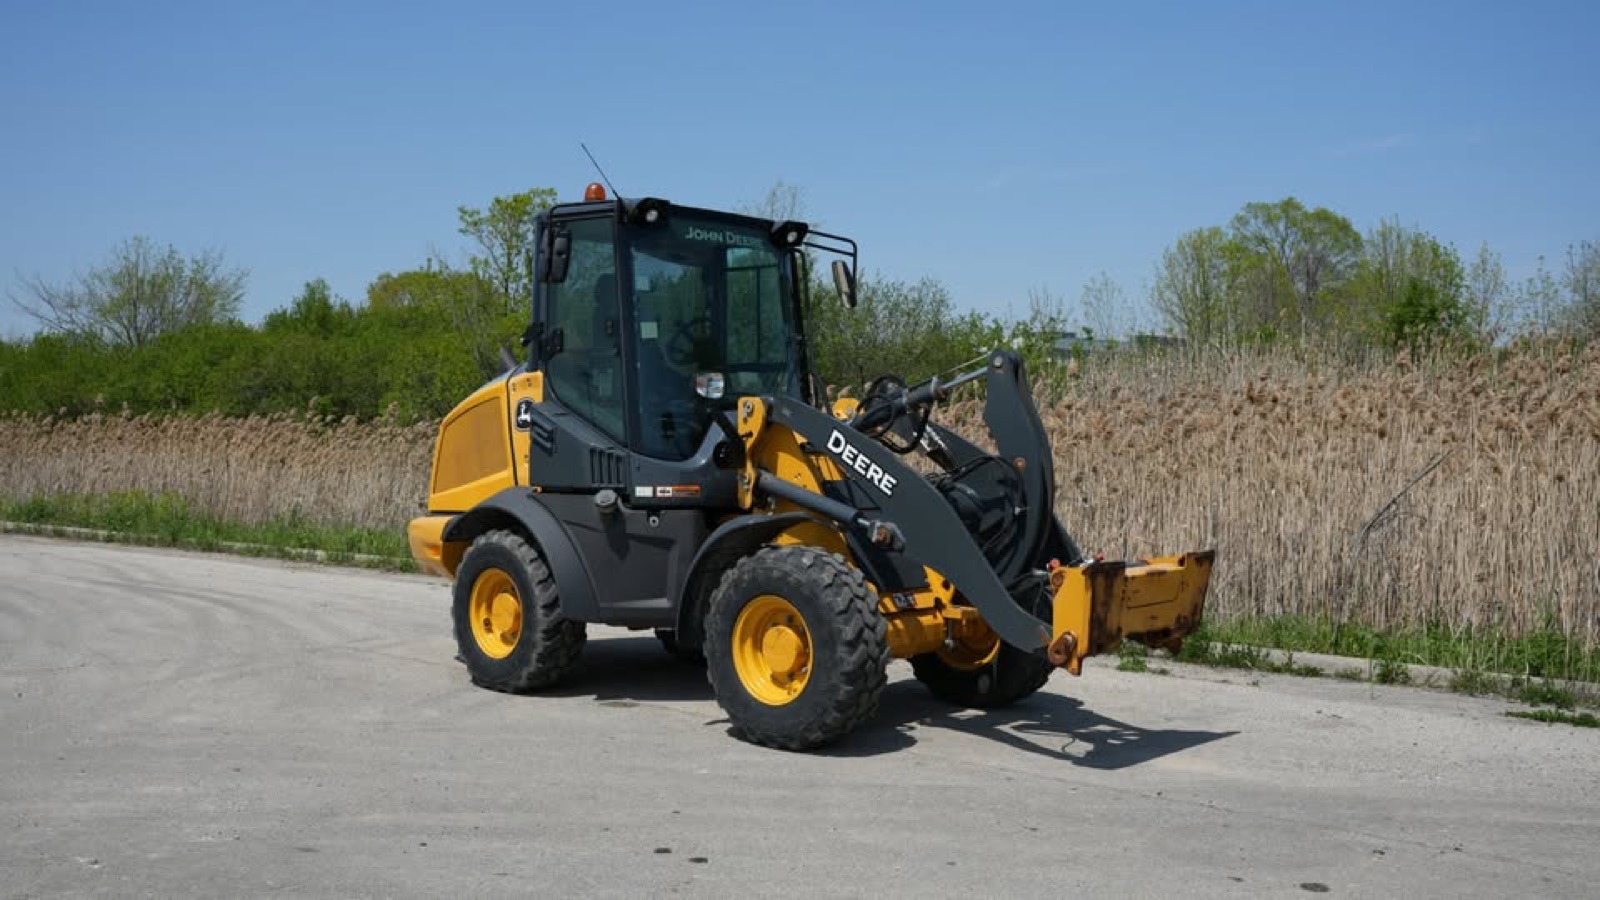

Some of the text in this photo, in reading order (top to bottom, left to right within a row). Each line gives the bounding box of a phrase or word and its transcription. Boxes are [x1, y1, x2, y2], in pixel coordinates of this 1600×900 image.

[684, 226, 764, 248] JOHN DEE
[826, 429, 897, 496] DEERE
